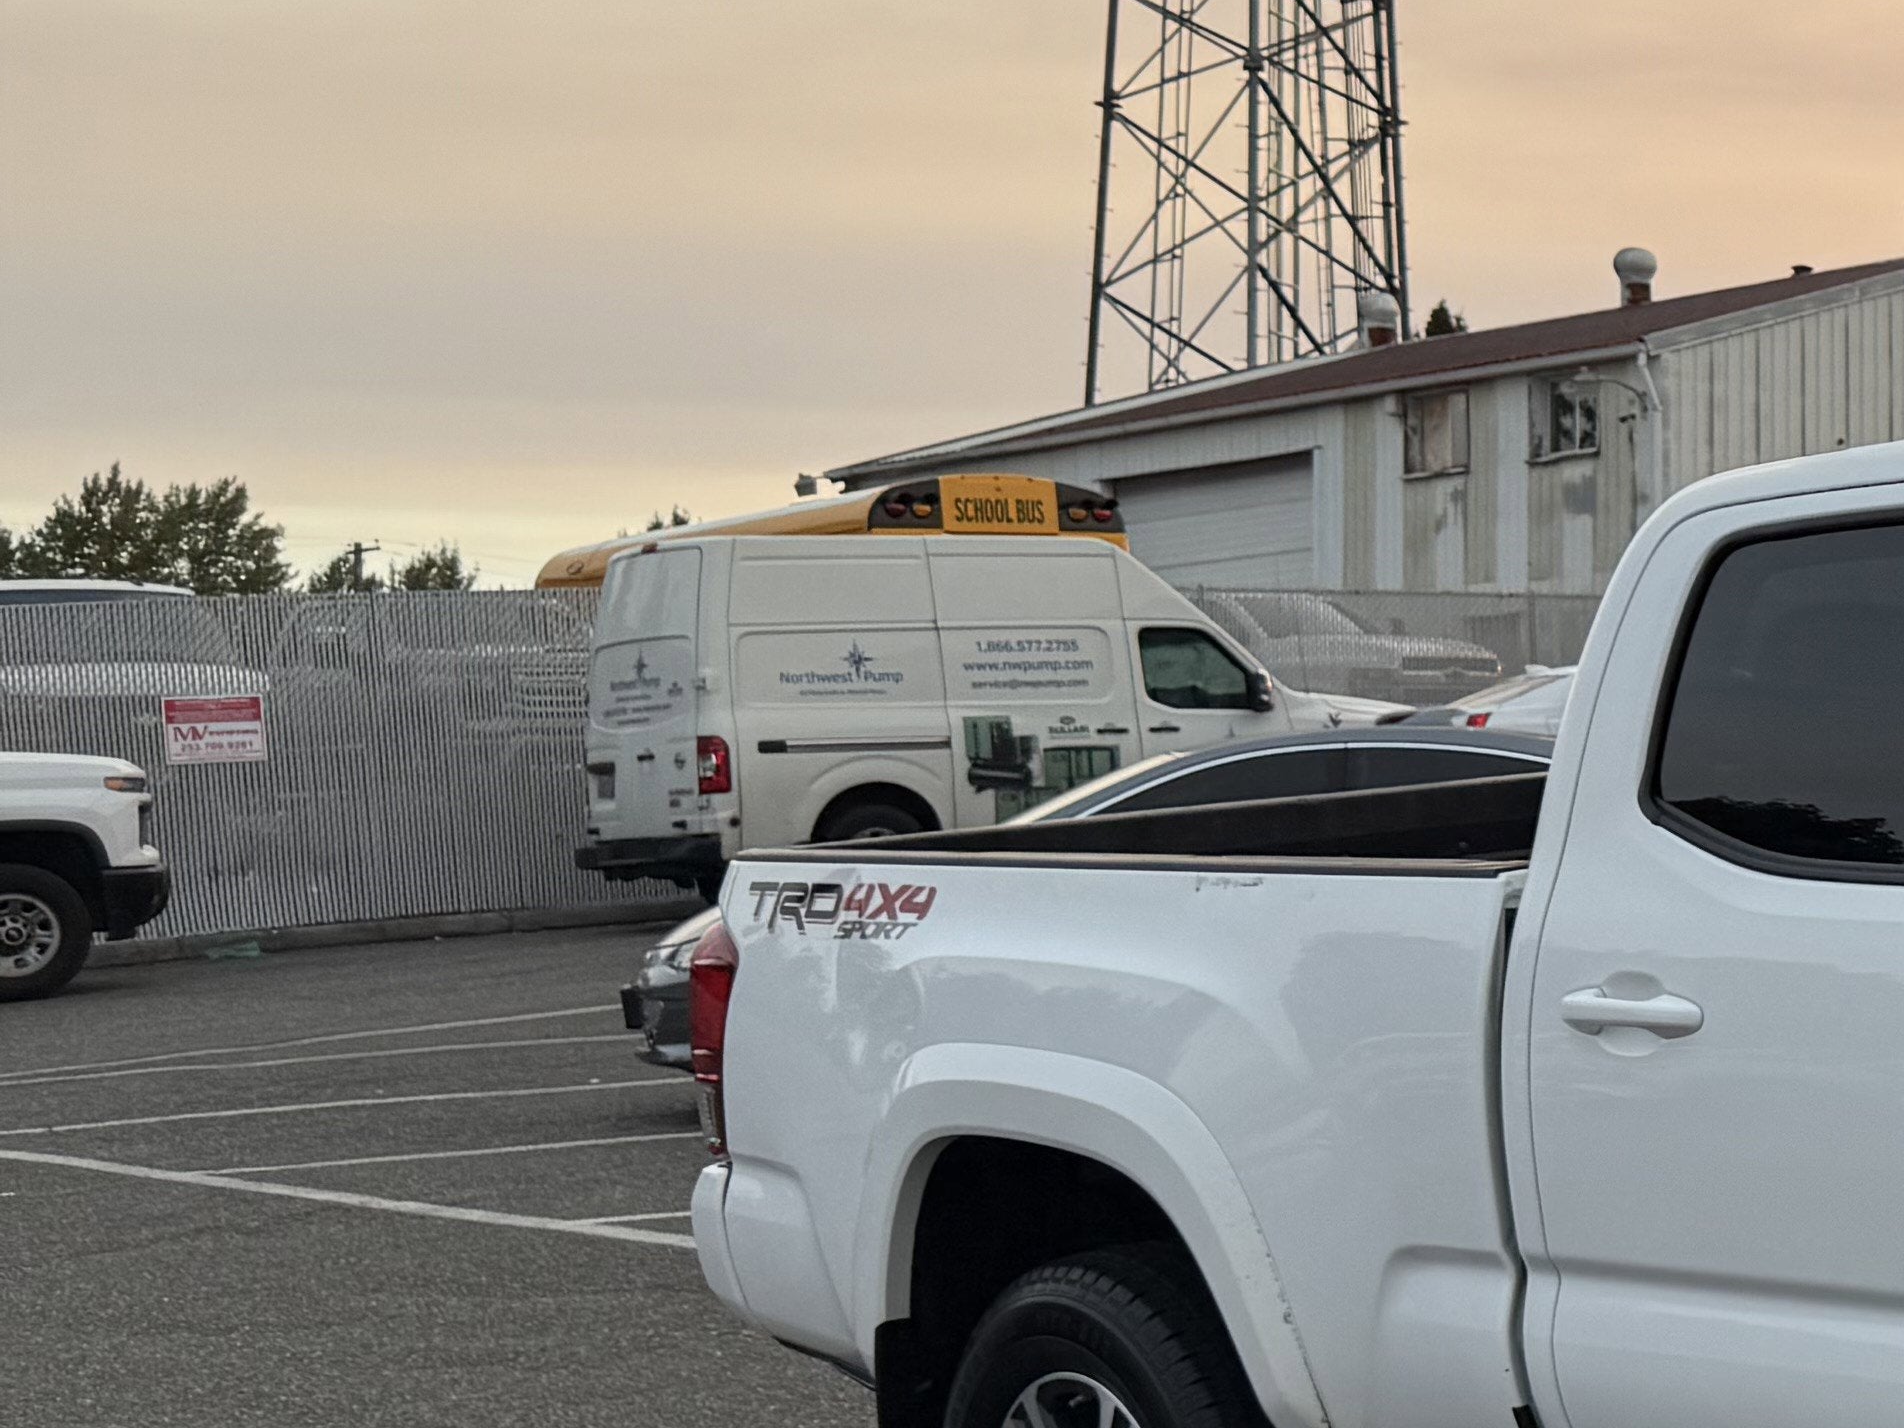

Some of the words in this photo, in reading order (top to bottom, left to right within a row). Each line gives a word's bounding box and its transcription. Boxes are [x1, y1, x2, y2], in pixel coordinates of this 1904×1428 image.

[954, 497, 1013, 524] SCHOOL
[1015, 498, 1045, 524] BUS
[963, 660, 1094, 673] www.nwpump.com
[780, 671, 853, 684] Northwest
[864, 670, 903, 683] Pump
[750, 881, 843, 934] TRD
[834, 921, 918, 940] SPORT
